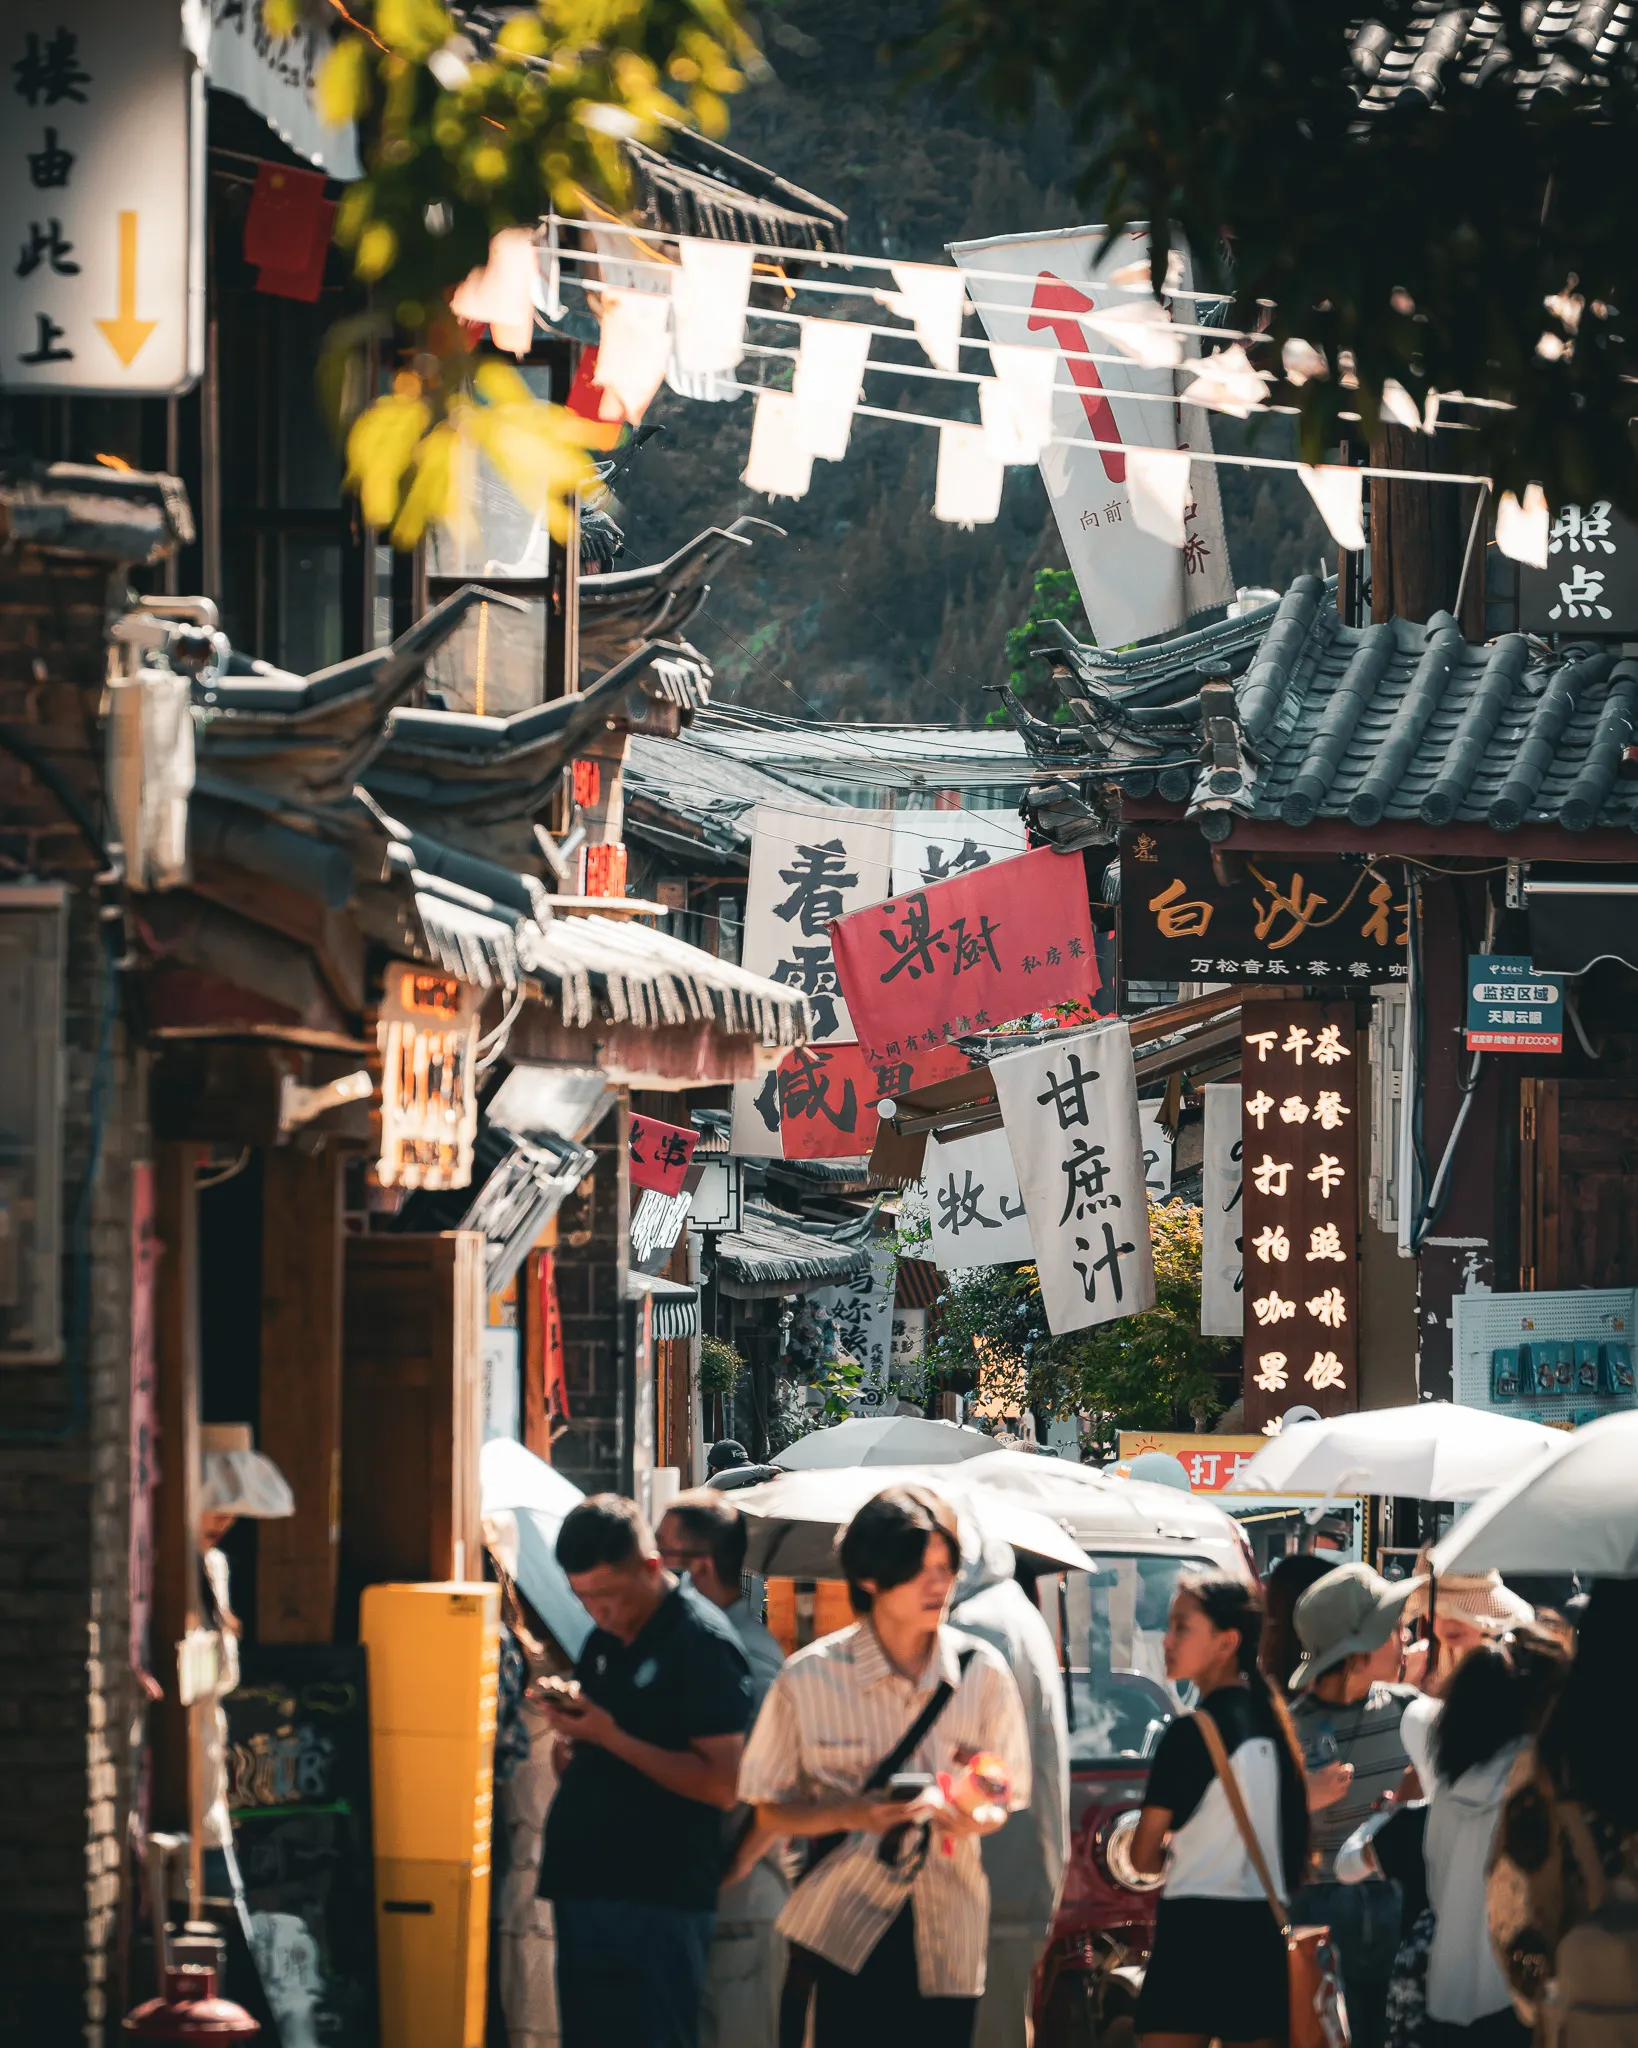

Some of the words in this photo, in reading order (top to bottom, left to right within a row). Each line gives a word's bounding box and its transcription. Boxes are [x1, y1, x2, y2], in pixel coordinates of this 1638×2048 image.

[13, 25, 94, 366] 楼由此上
[1079, 498, 1130, 531] 向前
[1548, 500, 1617, 620] 照点
[1021, 937, 1086, 975] 私房菜
[1483, 985, 1549, 1002] 监控区域
[868, 1009, 991, 1063] 人间有味是清欢
[1245, 1024, 1351, 1066] 下午茶
[1245, 1090, 1351, 1130] 中西餐
[1252, 1152, 1345, 1199] 打卡
[1252, 1222, 1347, 1264] 拍照
[1252, 1286, 1347, 1329] 咖啡
[1252, 1351, 1347, 1392] 果饮
